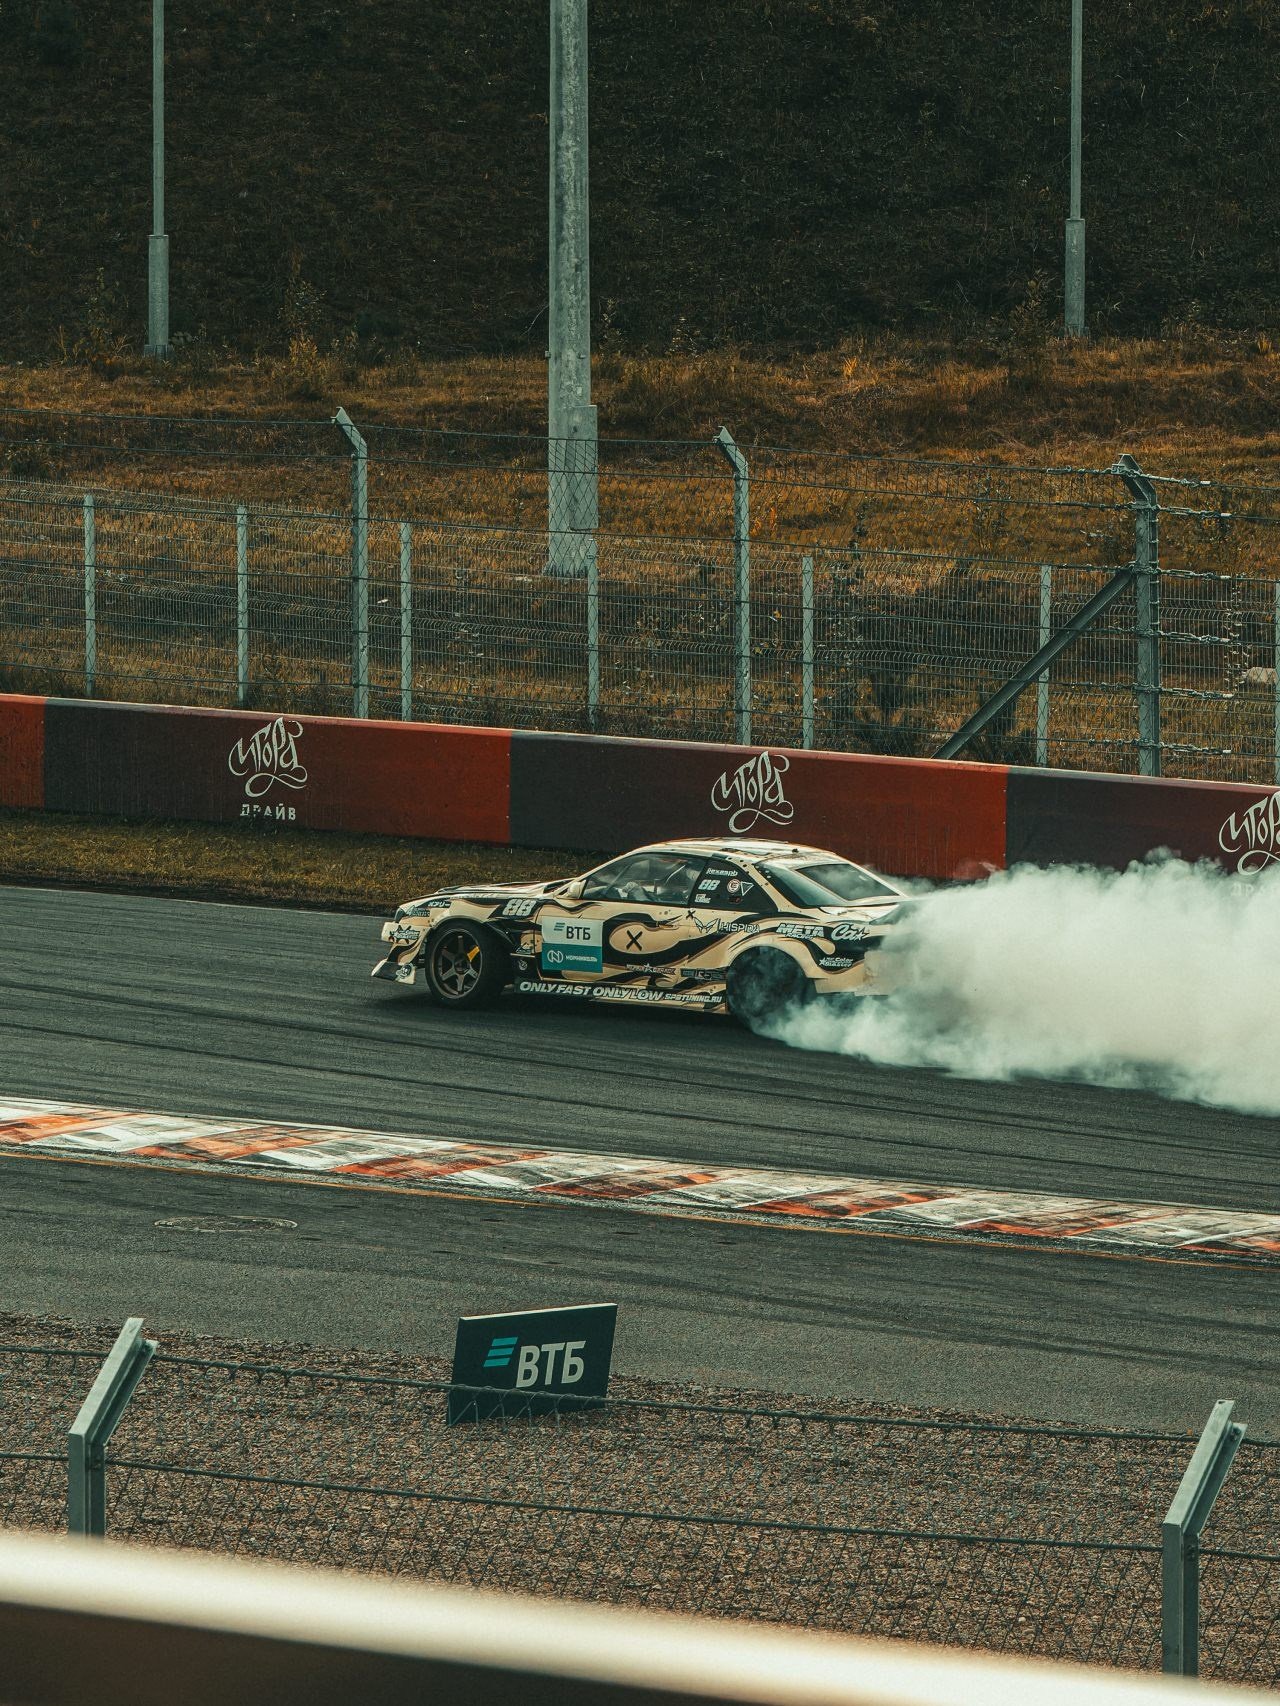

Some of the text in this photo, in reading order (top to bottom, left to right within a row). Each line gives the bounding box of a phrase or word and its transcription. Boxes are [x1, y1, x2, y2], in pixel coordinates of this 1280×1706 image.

[240, 803, 296, 820] ДРАЙВ
[698, 879, 720, 890] 88
[502, 899, 537, 916] 88
[566, 926, 591, 940] ВТБ
[776, 923, 824, 937] META
[520, 981, 557, 993] ONLY
[556, 984, 592, 996] FAST
[592, 986, 631, 998] ONLY
[629, 989, 664, 1001] LOW
[516, 1341, 586, 1388] ВТБ
